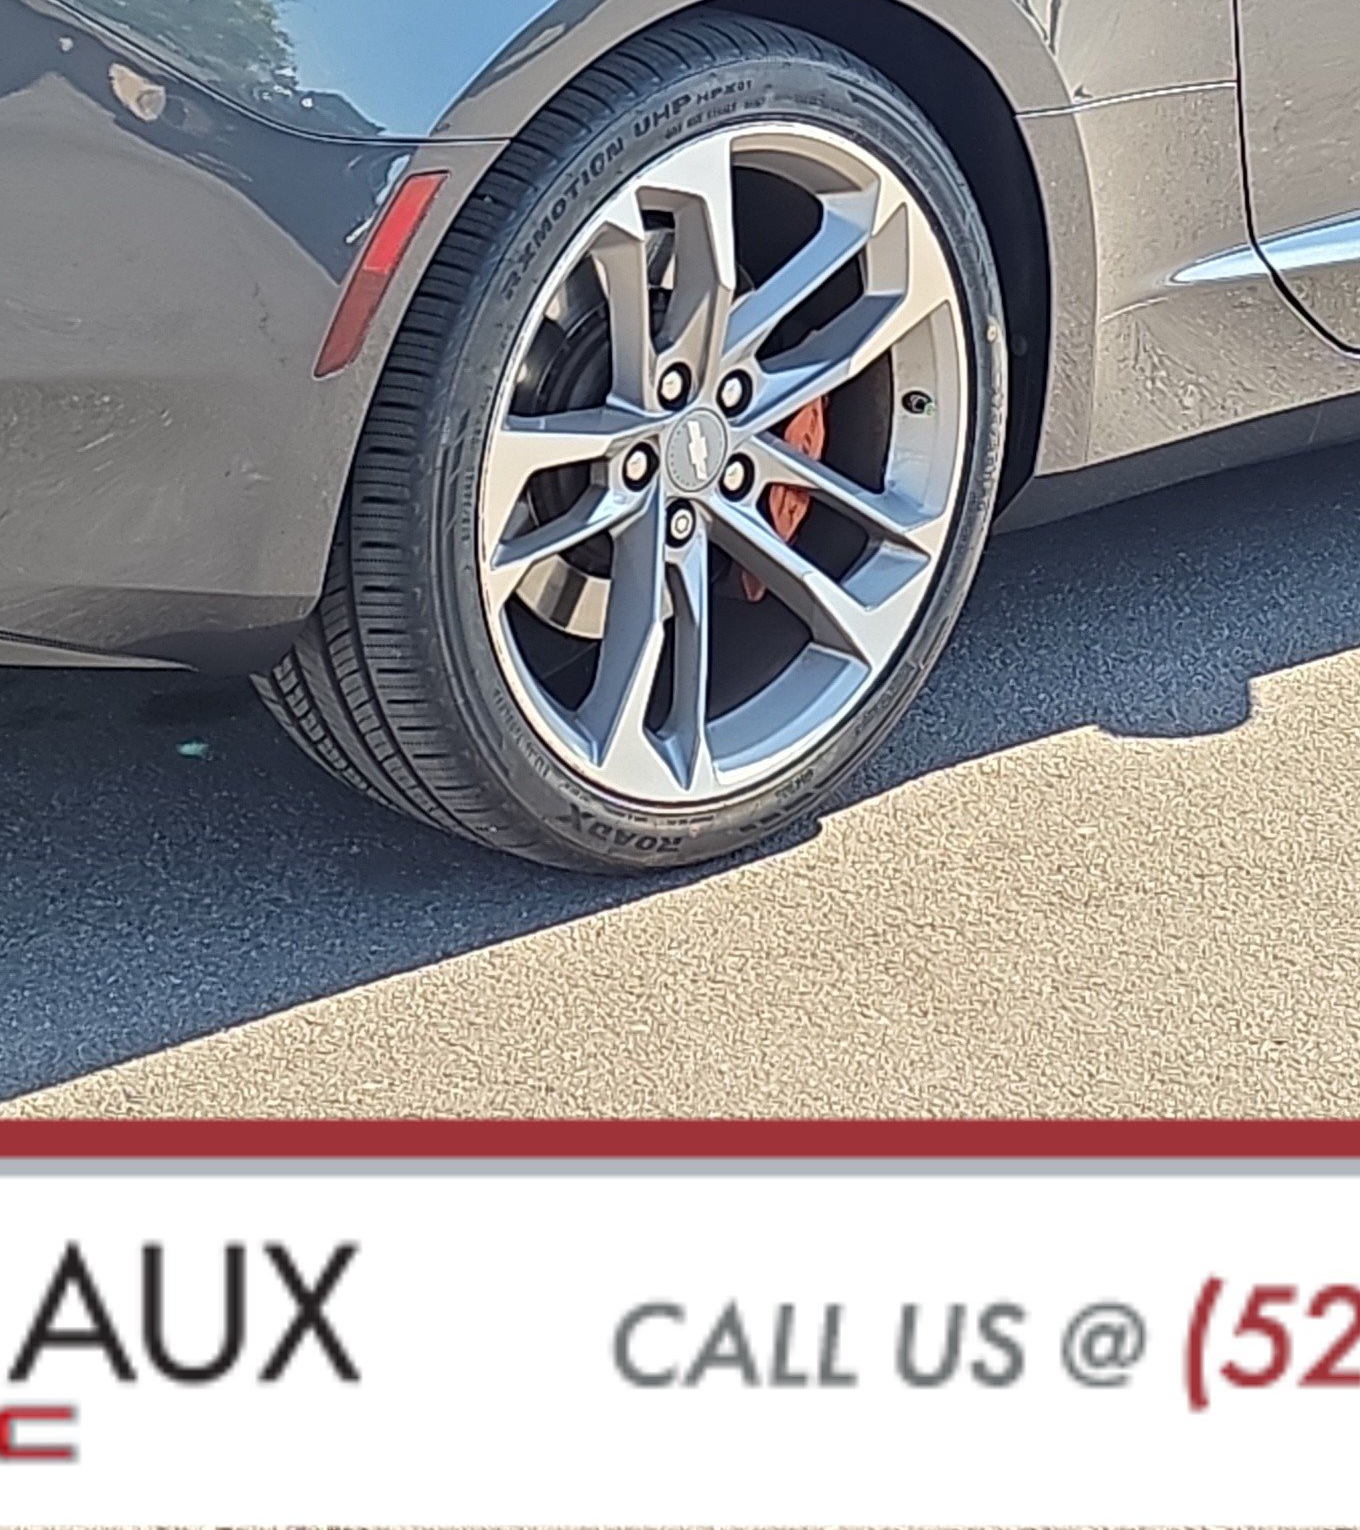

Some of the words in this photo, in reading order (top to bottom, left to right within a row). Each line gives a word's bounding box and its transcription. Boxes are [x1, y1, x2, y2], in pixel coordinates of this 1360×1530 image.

[499, 136, 625, 301] RXMOTION
[633, 93, 692, 138] UHP
[555, 802, 685, 854] ROADX
